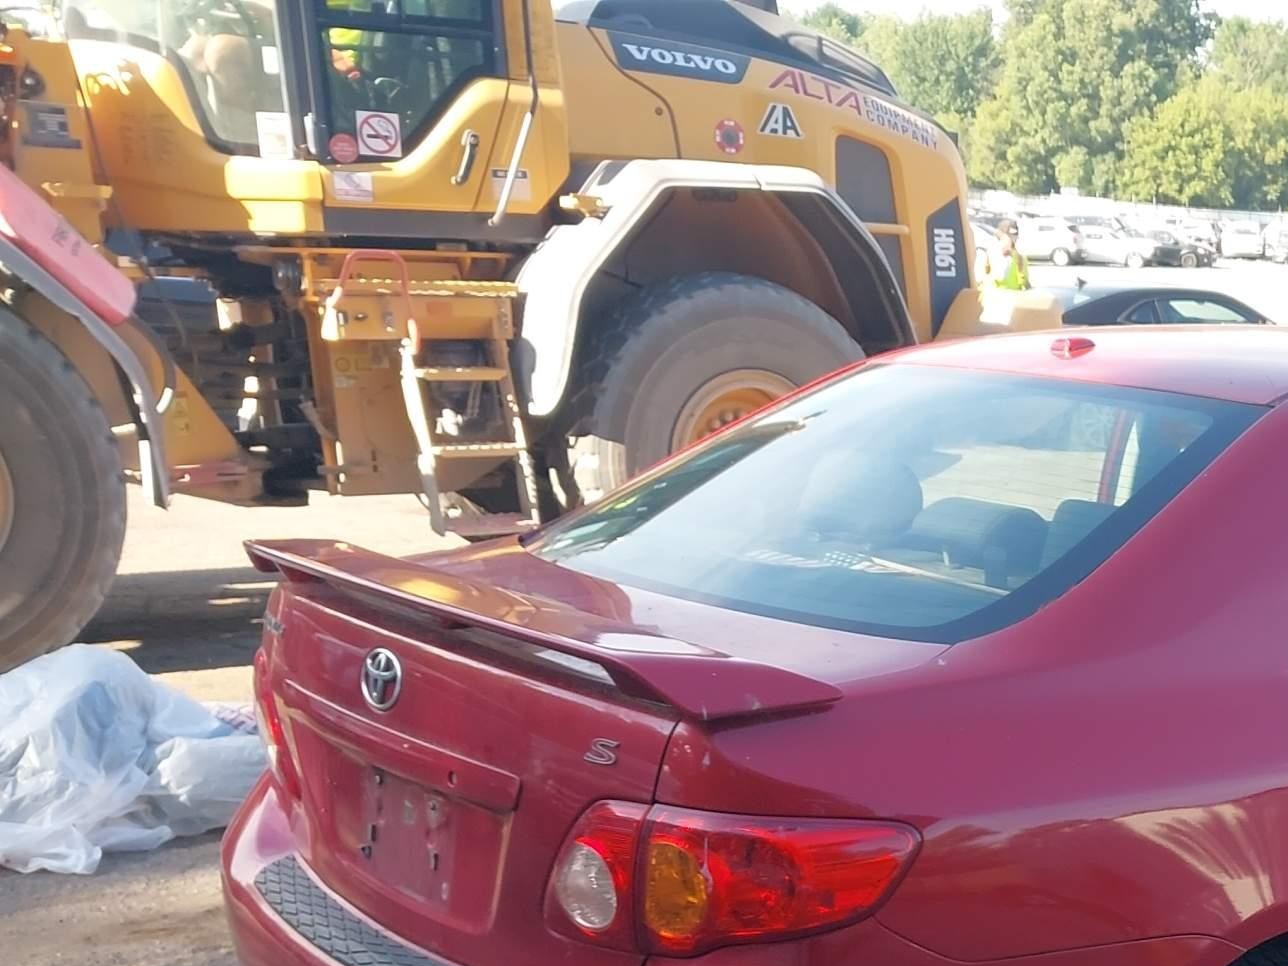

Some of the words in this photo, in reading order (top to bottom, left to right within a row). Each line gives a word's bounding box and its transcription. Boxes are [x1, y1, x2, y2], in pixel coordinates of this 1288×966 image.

[622, 43, 737, 74] VOLVO
[768, 69, 862, 116] ALTA
[866, 109, 937, 150] COMPANY
[933, 228, 957, 277] L90H
[584, 737, 620, 765] S
